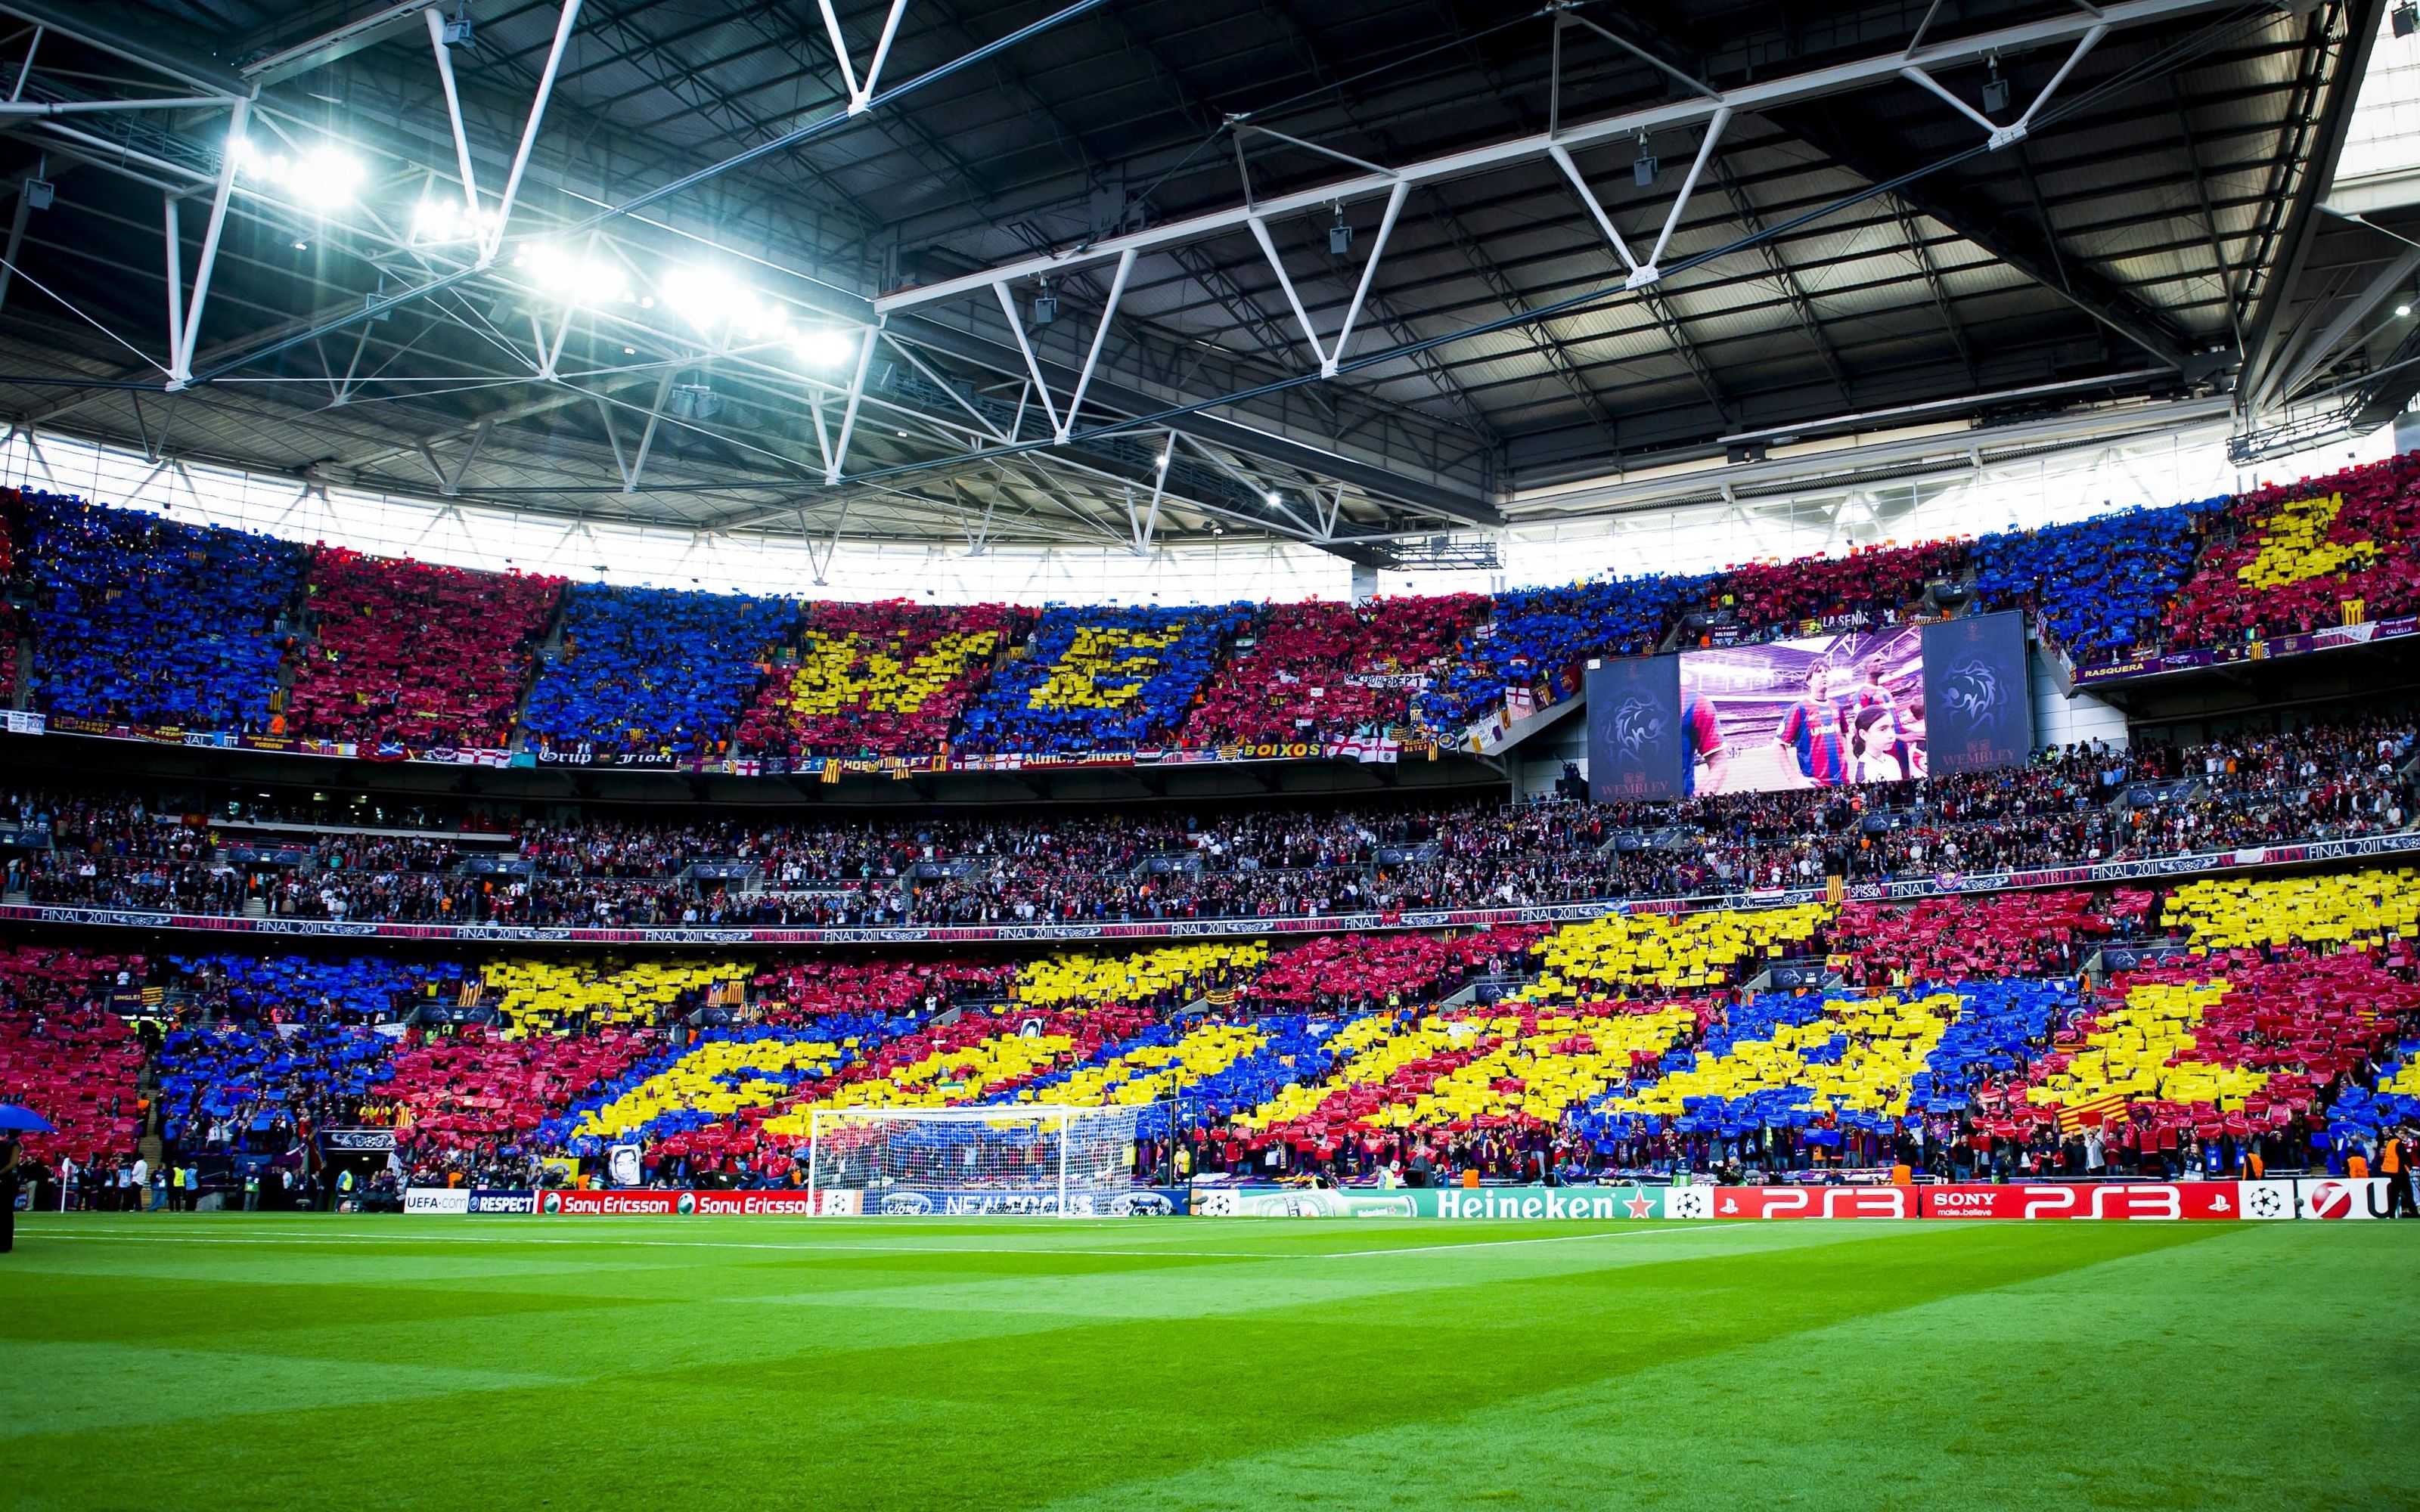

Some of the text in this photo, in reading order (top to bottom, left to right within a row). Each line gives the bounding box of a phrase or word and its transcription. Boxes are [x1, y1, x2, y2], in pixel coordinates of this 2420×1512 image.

[2084, 662, 2145, 678] RASQUERA
[538, 751, 593, 765] Grup
[1244, 743, 1322, 758] BOIXOS
[1943, 748, 2015, 767] WEMBLEY
[1600, 779, 1669, 795] WEMBLEY
[42, 909, 83, 923] FINAL
[87, 912, 111, 924] 2011
[172, 916, 252, 931] WEMBLEY
[256, 921, 295, 932] FINAL
[299, 922, 321, 934] 2011
[377, 925, 452, 938] WEMBLEY
[457, 928, 494, 939] FINAL
[497, 929, 517, 940] 2011
[570, 930, 641, 941] WEMBLEY
[645, 931, 680, 942] FINAL
[682, 931, 703, 941] 2011
[752, 931, 821, 941] WEMBLEY
[824, 931, 858, 941] FINAL
[859, 931, 880, 941] 2011
[928, 929, 995, 940] WEMBLEY
[998, 929, 1032, 940] FINAL
[1033, 928, 1053, 938] 2011
[1101, 925, 1169, 937] WEMBLEY
[1171, 923, 1205, 935] FINAL
[1206, 922, 1226, 934] 2011
[1274, 918, 1343, 931] WEMBLEY
[1345, 916, 1379, 928] FINAL
[1449, 910, 1519, 925] WEMBLEY
[1521, 908, 1556, 921] FINAL
[1557, 906, 1577, 918] 2011
[1891, 884, 1927, 897] FINAL
[2010, 870, 2090, 888] WEMBLEY
[2092, 866, 2132, 881] FINAL
[2135, 863, 2158, 876] 2011
[2220, 847, 2305, 867] WBLEY
[2309, 842, 2353, 860] FINAL
[2355, 838, 2381, 853] 2011
[479, 1197, 534, 1212] RESPECT
[564, 1197, 670, 1214] Sony Ericsson
[700, 1197, 808, 1214] Sony Ericsso
[1436, 1189, 1616, 1219] Heineken
[1762, 1188, 1905, 1219] PS3
[1934, 1193, 1998, 1207] SONY
[2024, 1185, 2182, 1219] PS3
[1938, 1208, 1993, 1217] make.believe
